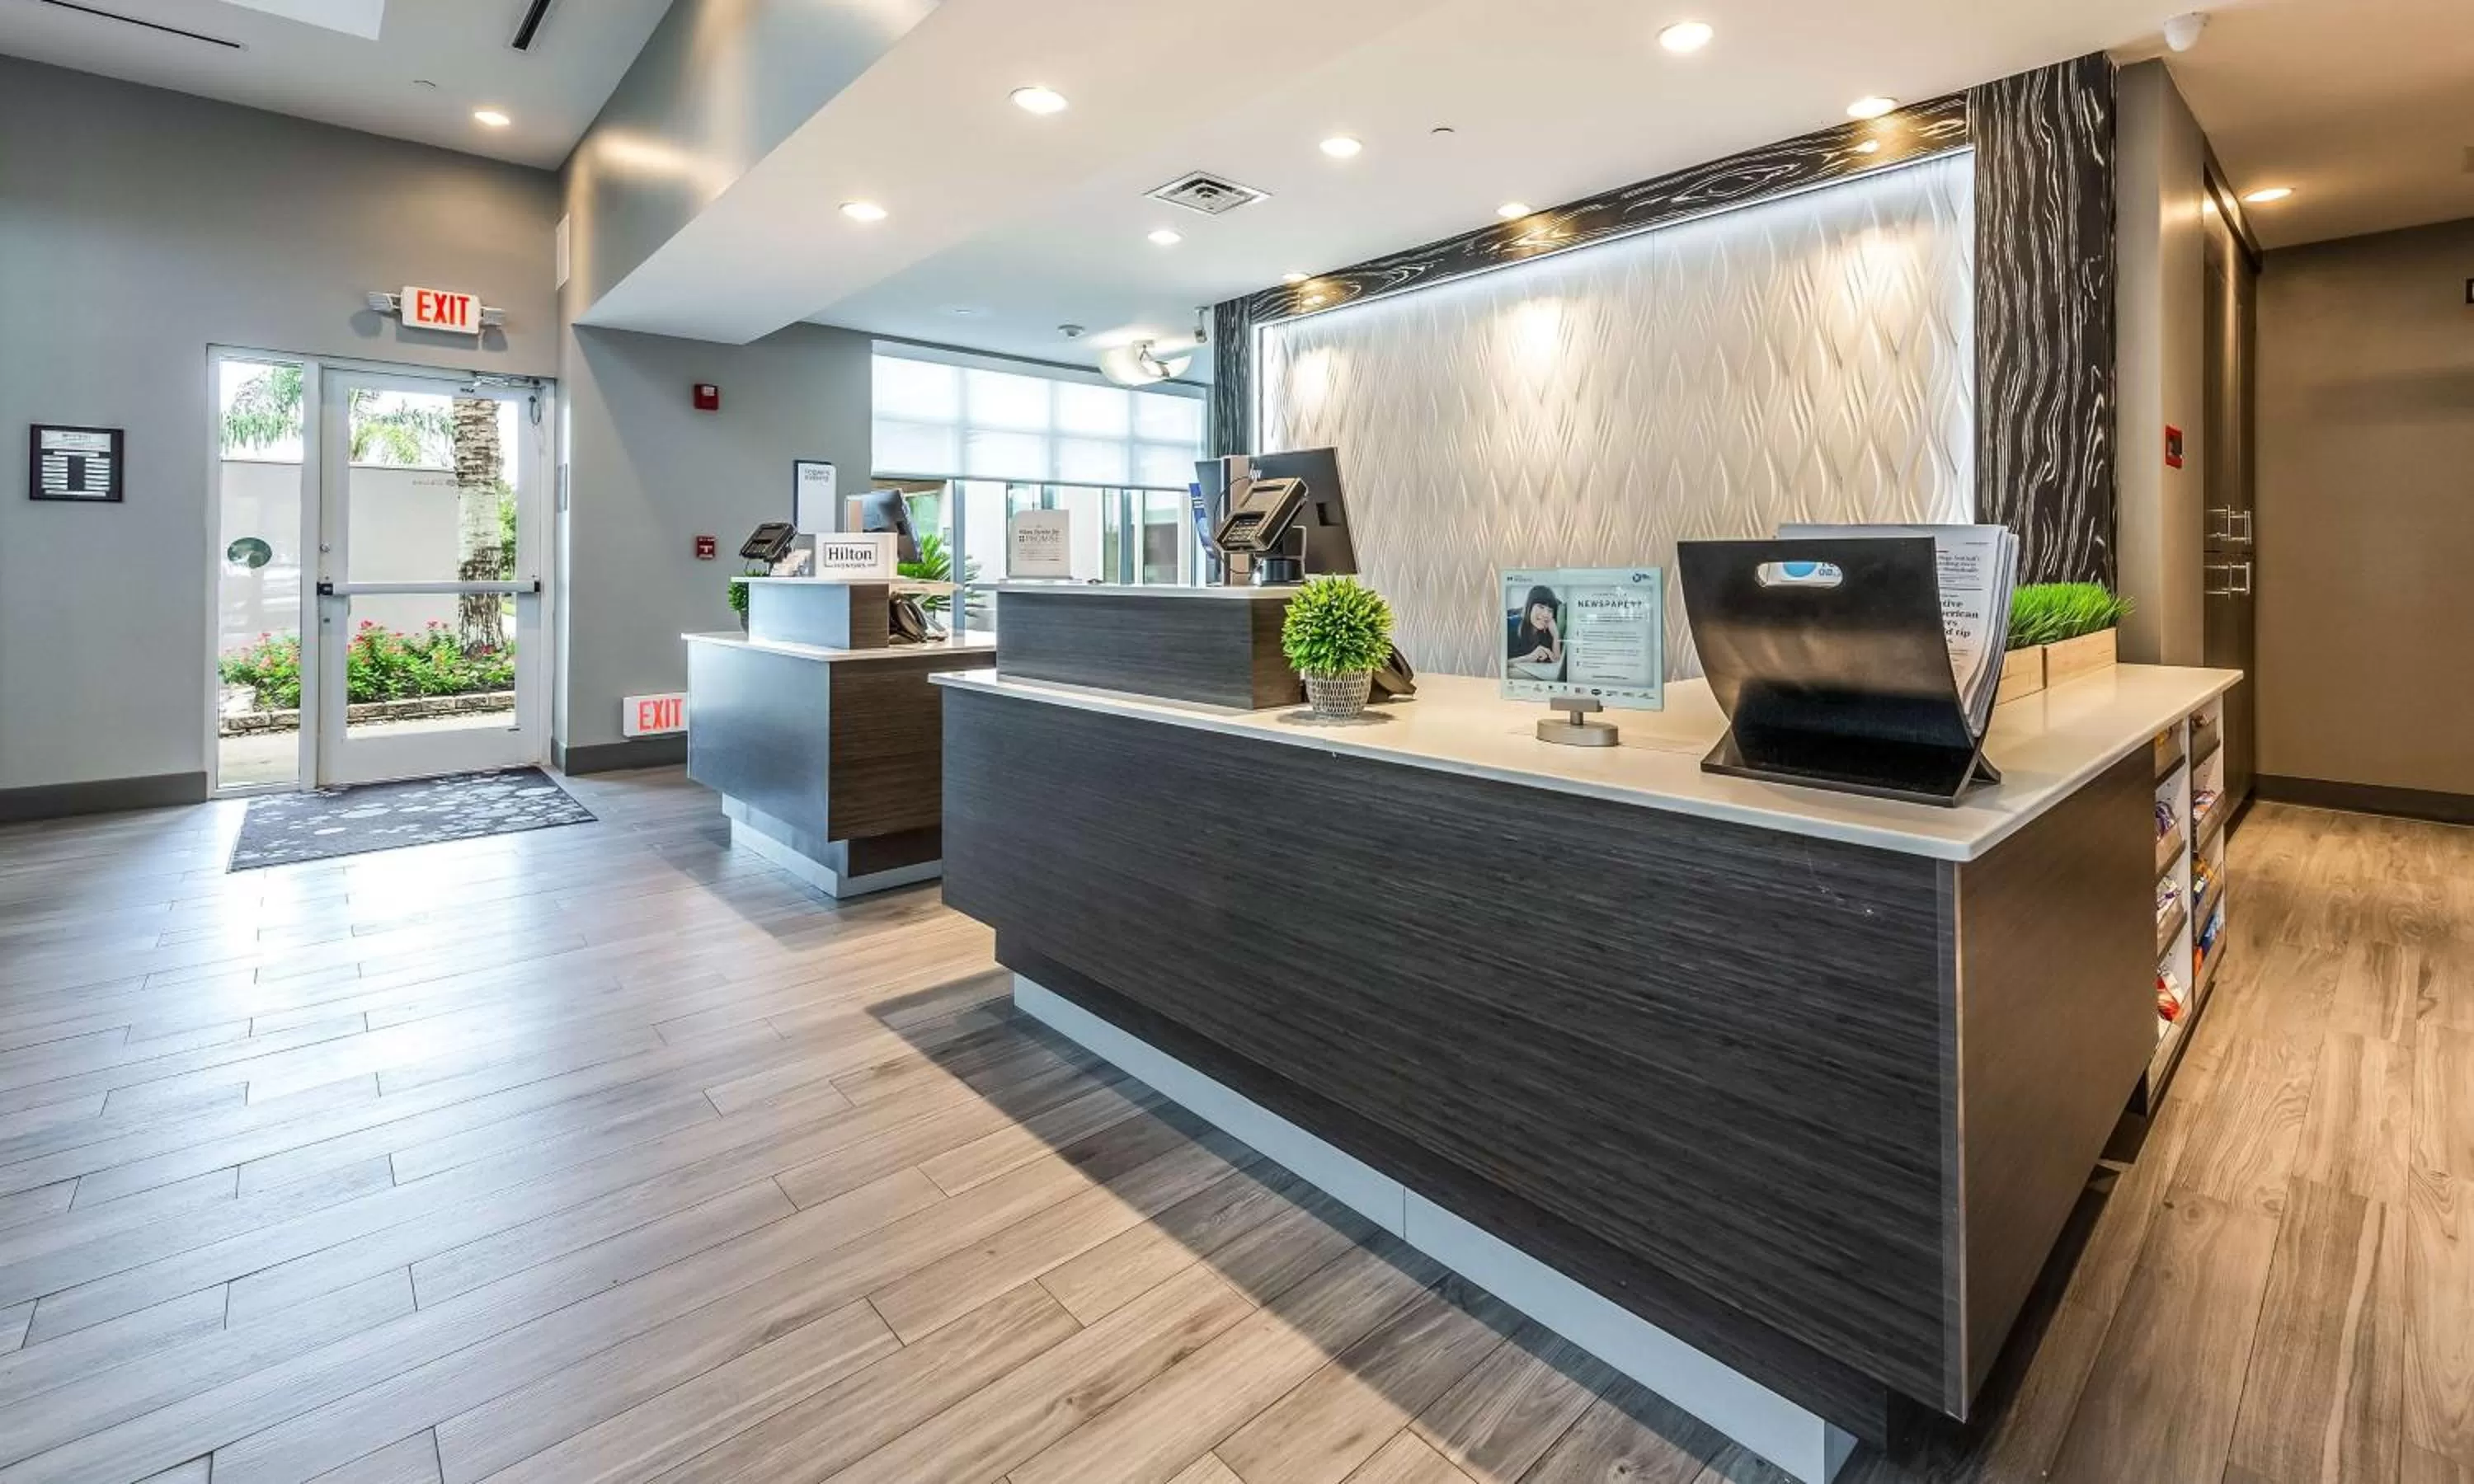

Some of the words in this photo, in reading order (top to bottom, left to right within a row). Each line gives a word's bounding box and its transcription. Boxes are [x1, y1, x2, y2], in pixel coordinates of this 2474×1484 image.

[417, 290, 469, 326] EXIT
[828, 547, 872, 561] Hilton
[639, 698, 683, 731] EXIT
